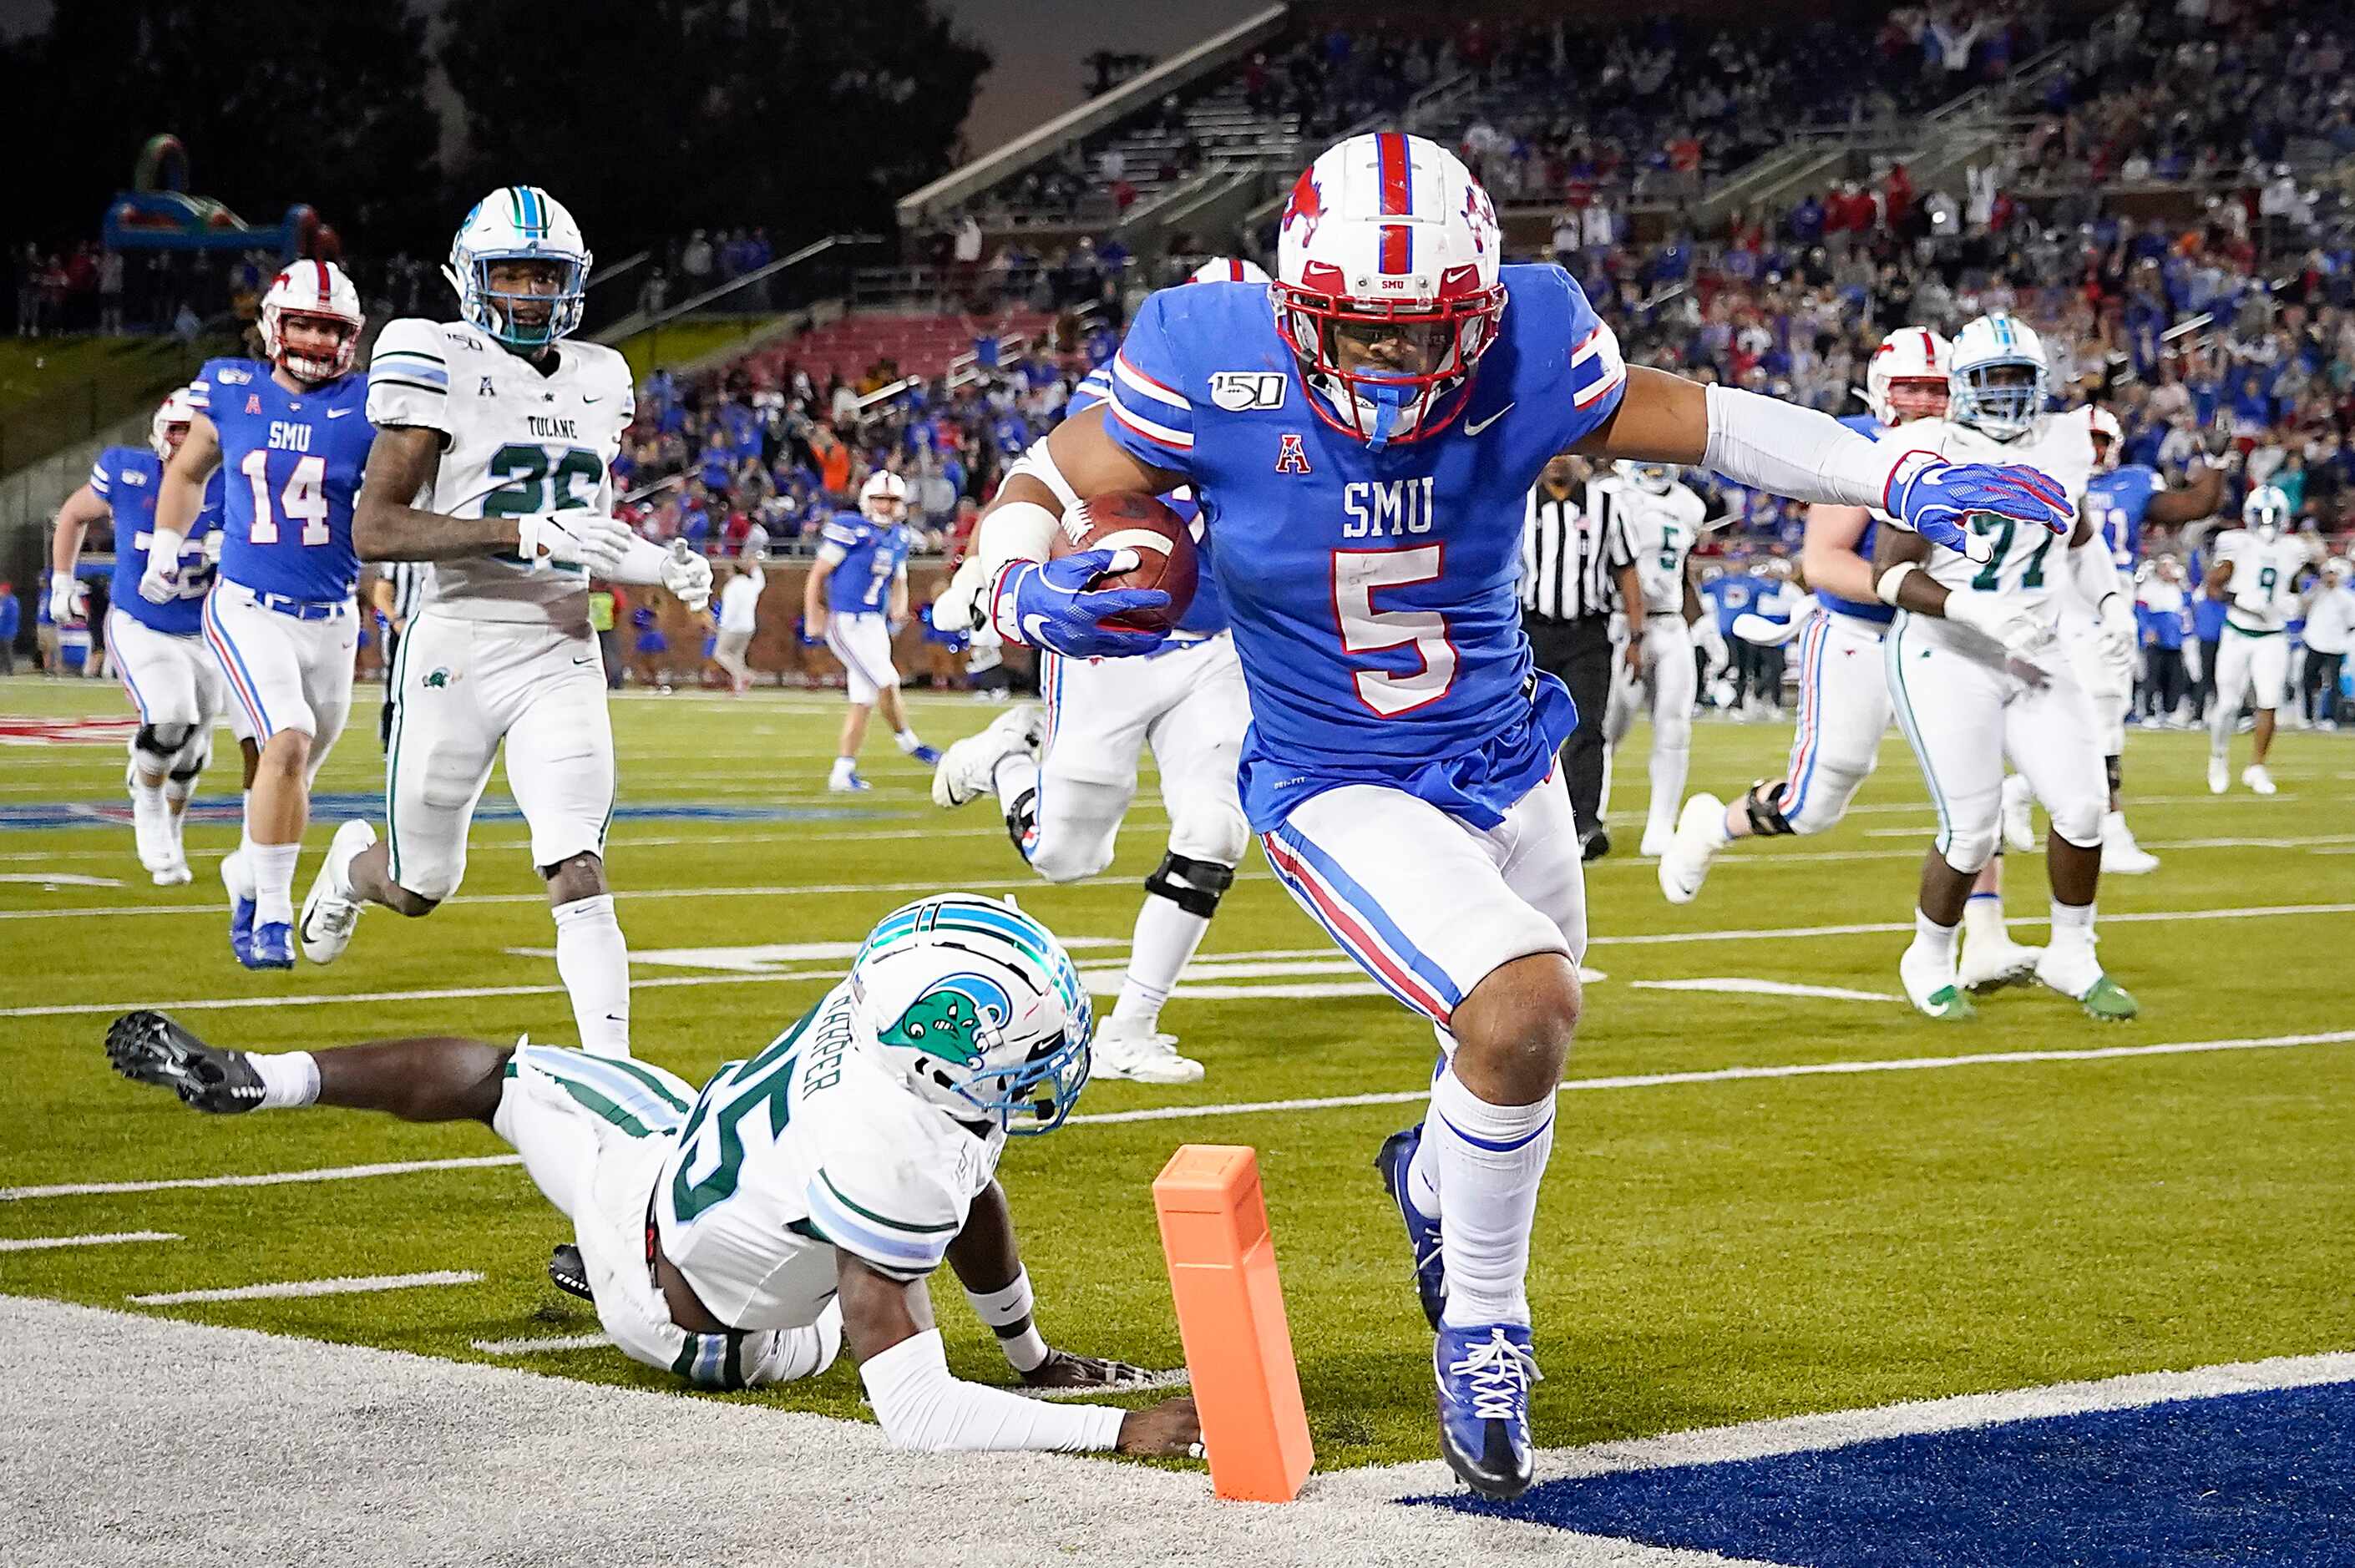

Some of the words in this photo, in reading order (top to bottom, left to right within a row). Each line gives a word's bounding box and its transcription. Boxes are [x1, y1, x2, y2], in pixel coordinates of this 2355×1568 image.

[1381, 280, 1404, 289] SMU
[1208, 372, 1287, 410] 150
[269, 421, 311, 453] SMU
[528, 416, 577, 439] TULANE
[1276, 434, 1311, 473] A
[242, 449, 330, 546] 14
[1343, 477, 1434, 538] SMU
[1660, 526, 1679, 569] 5
[2261, 567, 2277, 602] 9
[1330, 542, 1460, 719] 5
